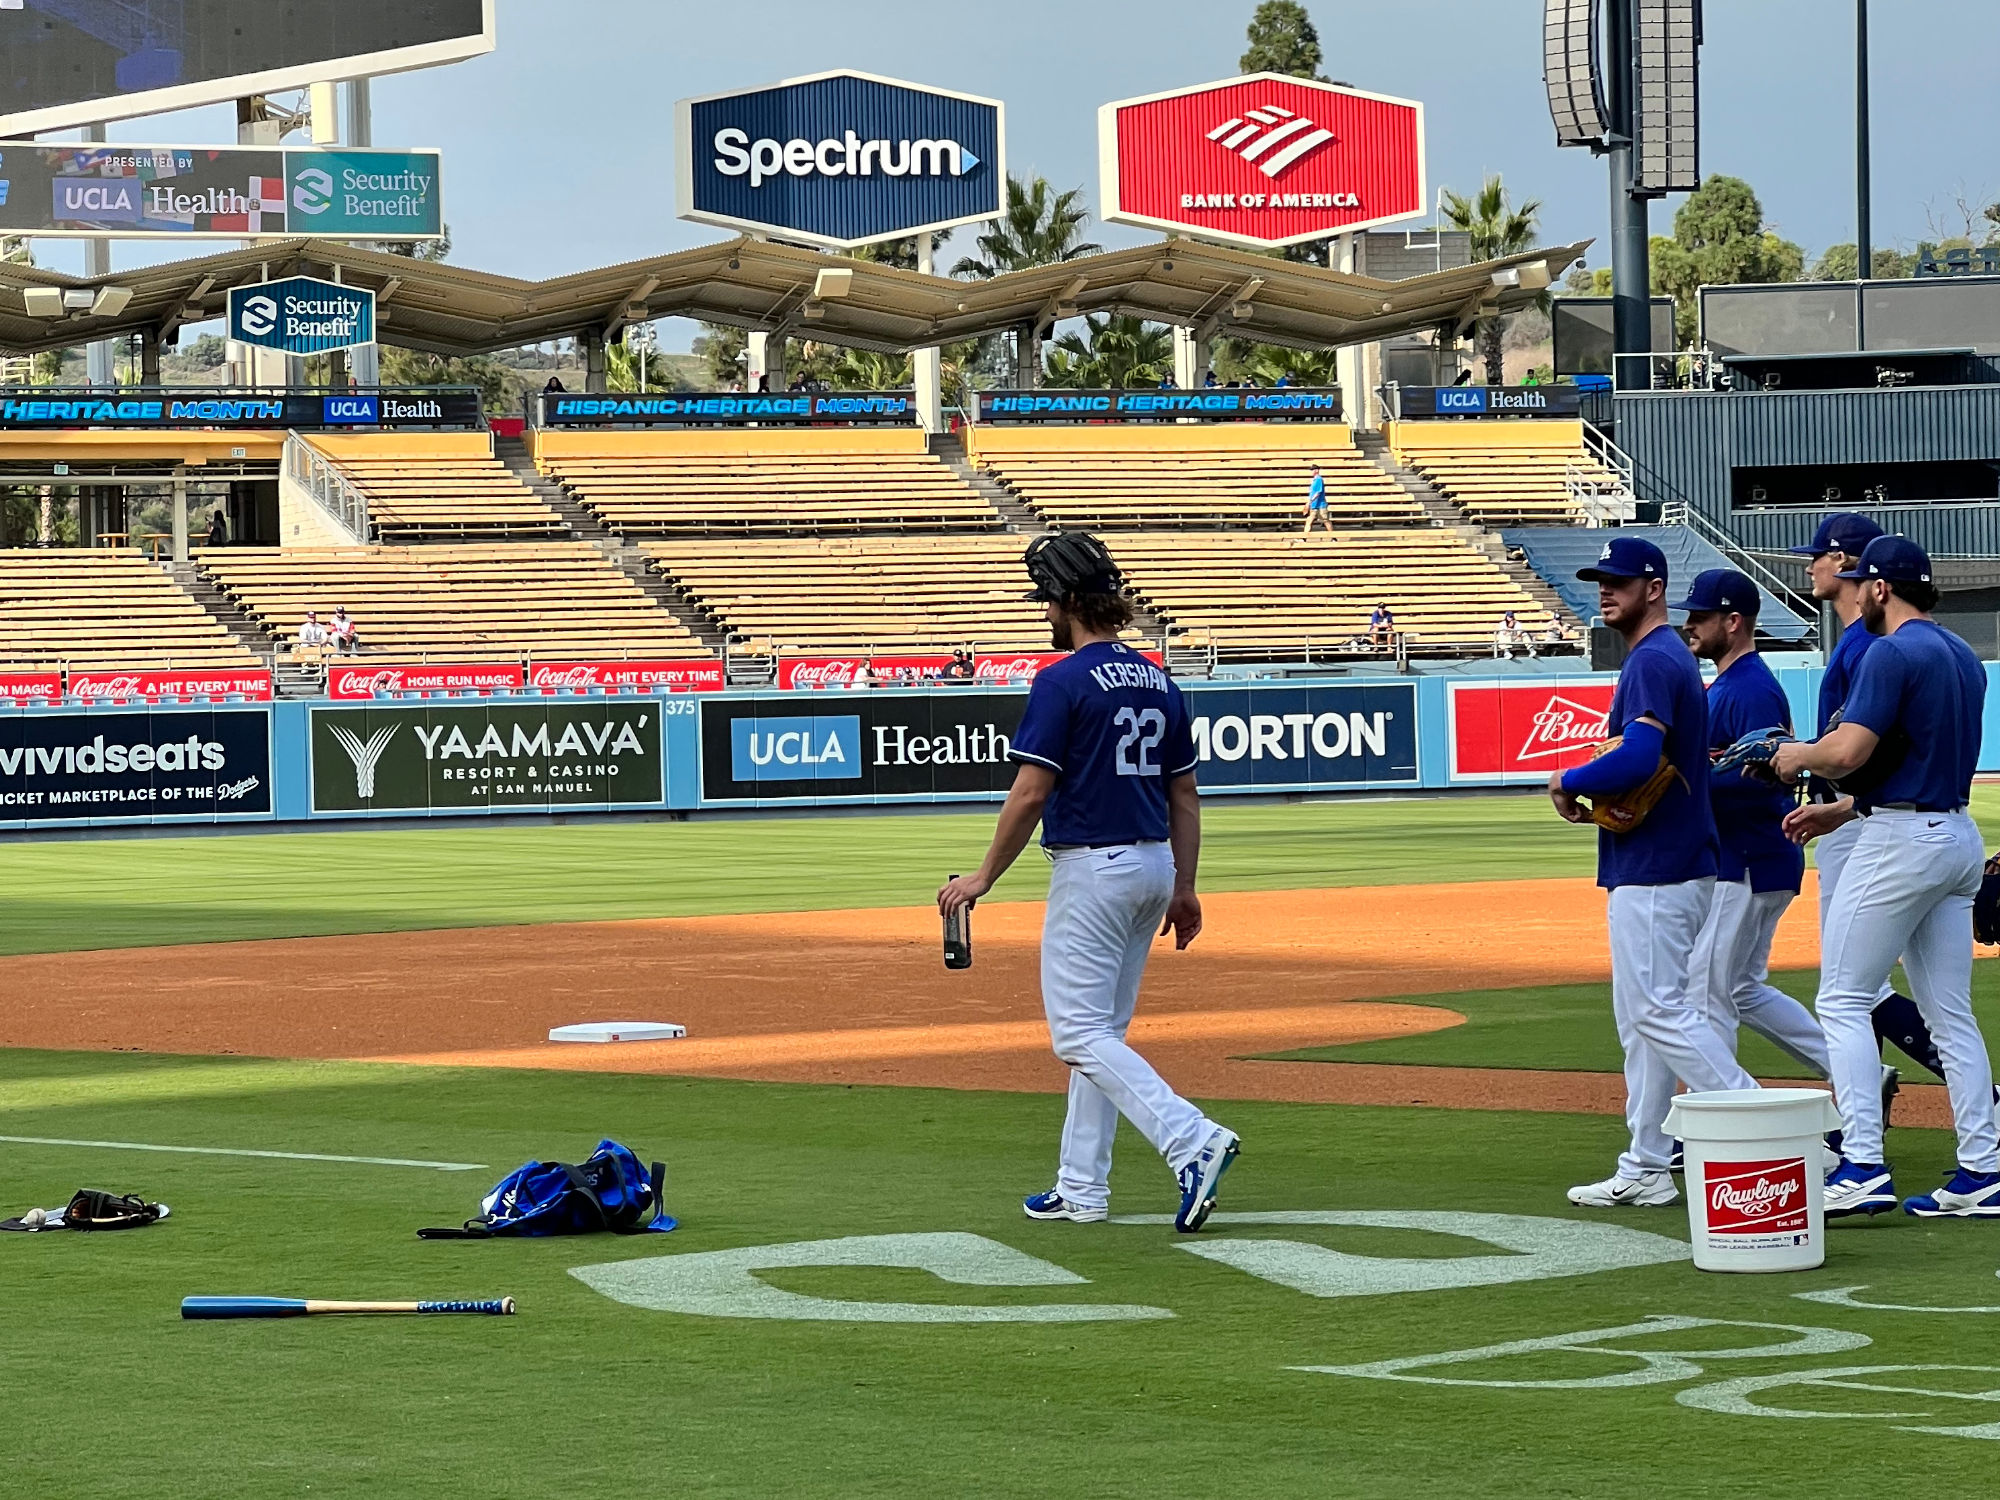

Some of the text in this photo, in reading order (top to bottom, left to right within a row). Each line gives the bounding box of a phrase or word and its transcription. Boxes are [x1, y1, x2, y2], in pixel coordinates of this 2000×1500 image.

[105, 156, 194, 168] PRESENTED BY
[713, 128, 961, 187] Spectrum
[343, 168, 431, 194] Security
[65, 186, 249, 215] UCLA Health
[345, 194, 421, 216] Benefit
[1181, 192, 1359, 208] BANK OF AMERICA
[285, 296, 361, 319] Security
[286, 316, 352, 336] Benefit
[331, 400, 442, 418] UCLA Health
[556, 398, 906, 416] HISPANIC HERITAGE MONTH
[992, 395, 1333, 412] HISPANIC HERITAGE MONTH
[1442, 391, 1546, 409] UCLA Health
[4, 400, 162, 419] HERITAGE
[170, 400, 282, 418] MONTH
[408, 674, 515, 687] HOME RUN MAGIC
[604, 670, 719, 683] A HIT EVERY TIME
[896, 667, 920, 677] RN
[12, 684, 53, 695] MAGIC
[147, 679, 267, 693] A HIT EVERY TIME
[666, 700, 694, 716] 375
[1533, 710, 1609, 742] Bud
[749, 723, 1011, 767] UCLA Health
[1114, 706, 1166, 776] 22
[443, 764, 619, 780] RESORT & CASINO
[49, 789, 156, 804] MARKETPLACE
[162, 788, 182, 799] OF
[186, 787, 213, 799] THE
[217, 775, 260, 801] Dodgers
[471, 782, 592, 795] AT SAN MANUEL
[1712, 1177, 1799, 1210] Rawlings
